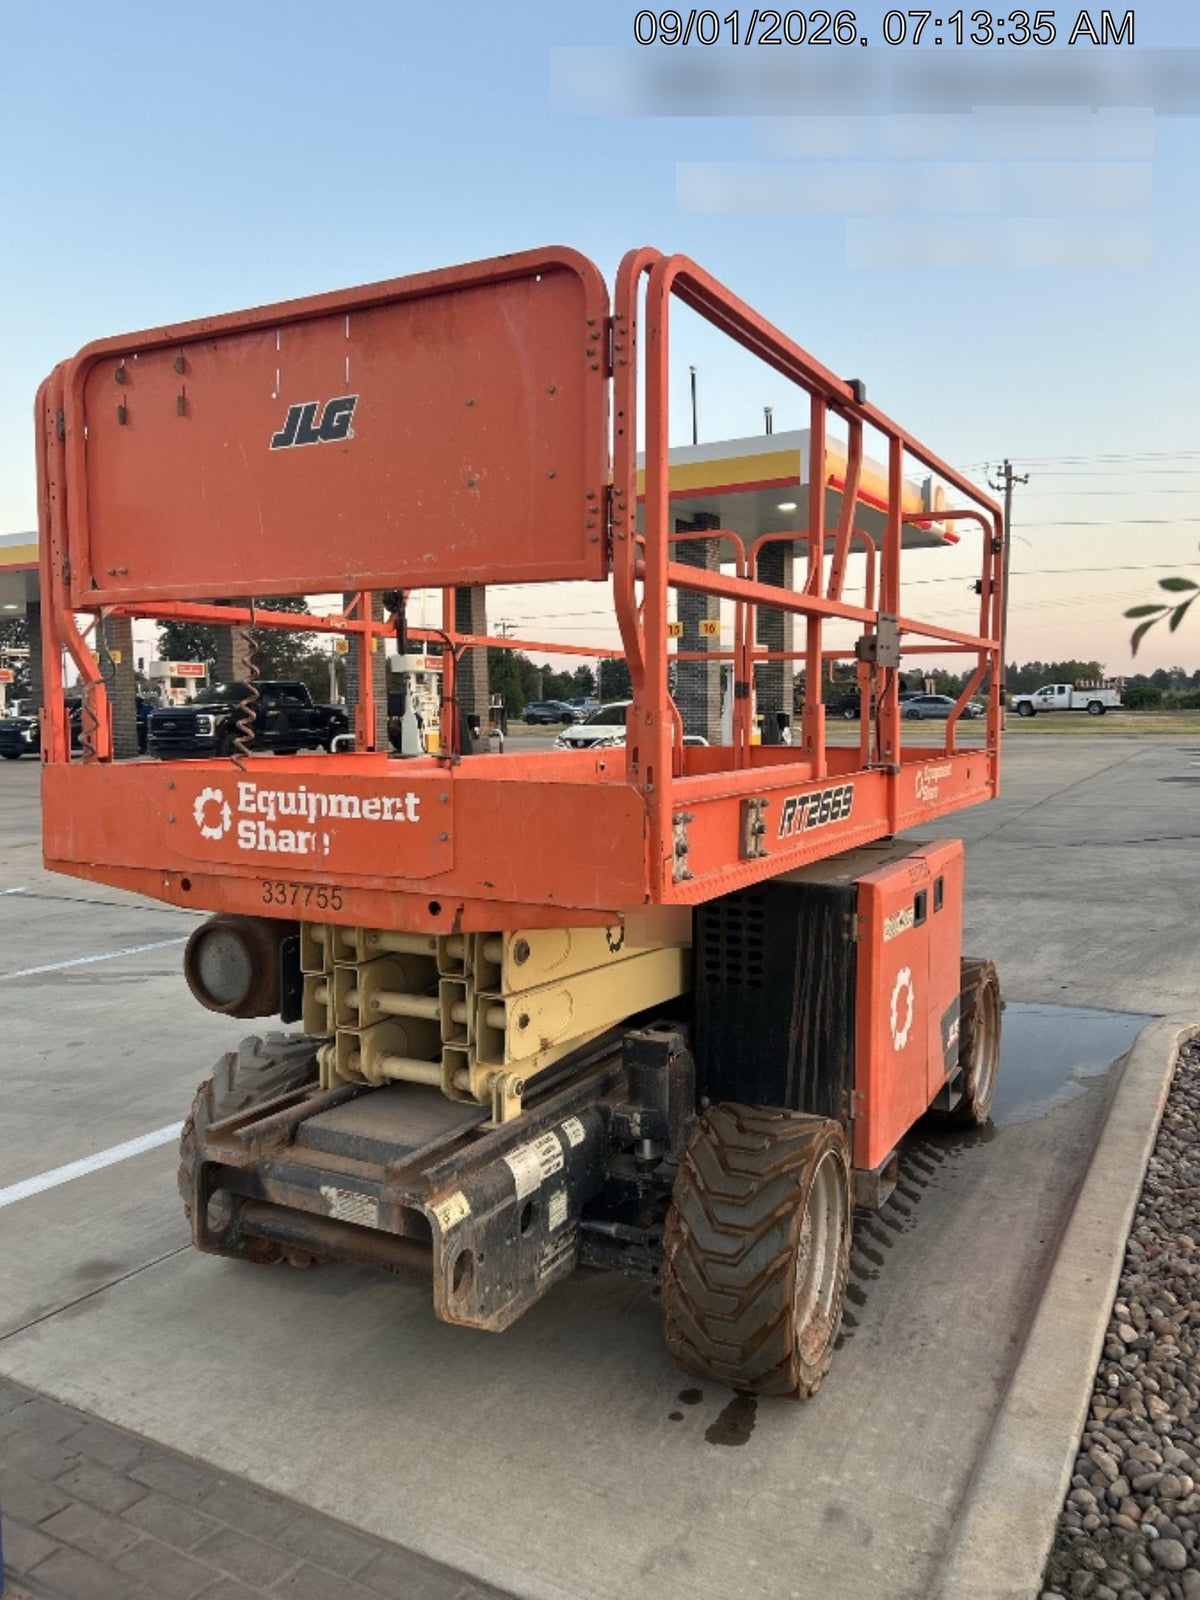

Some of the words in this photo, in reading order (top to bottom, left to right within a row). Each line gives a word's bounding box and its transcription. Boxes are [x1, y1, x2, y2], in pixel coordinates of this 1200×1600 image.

[268, 394, 359, 450] JLG
[237, 781, 421, 823] Equipment
[777, 782, 854, 841] RT2669
[262, 881, 343, 911] 337755
